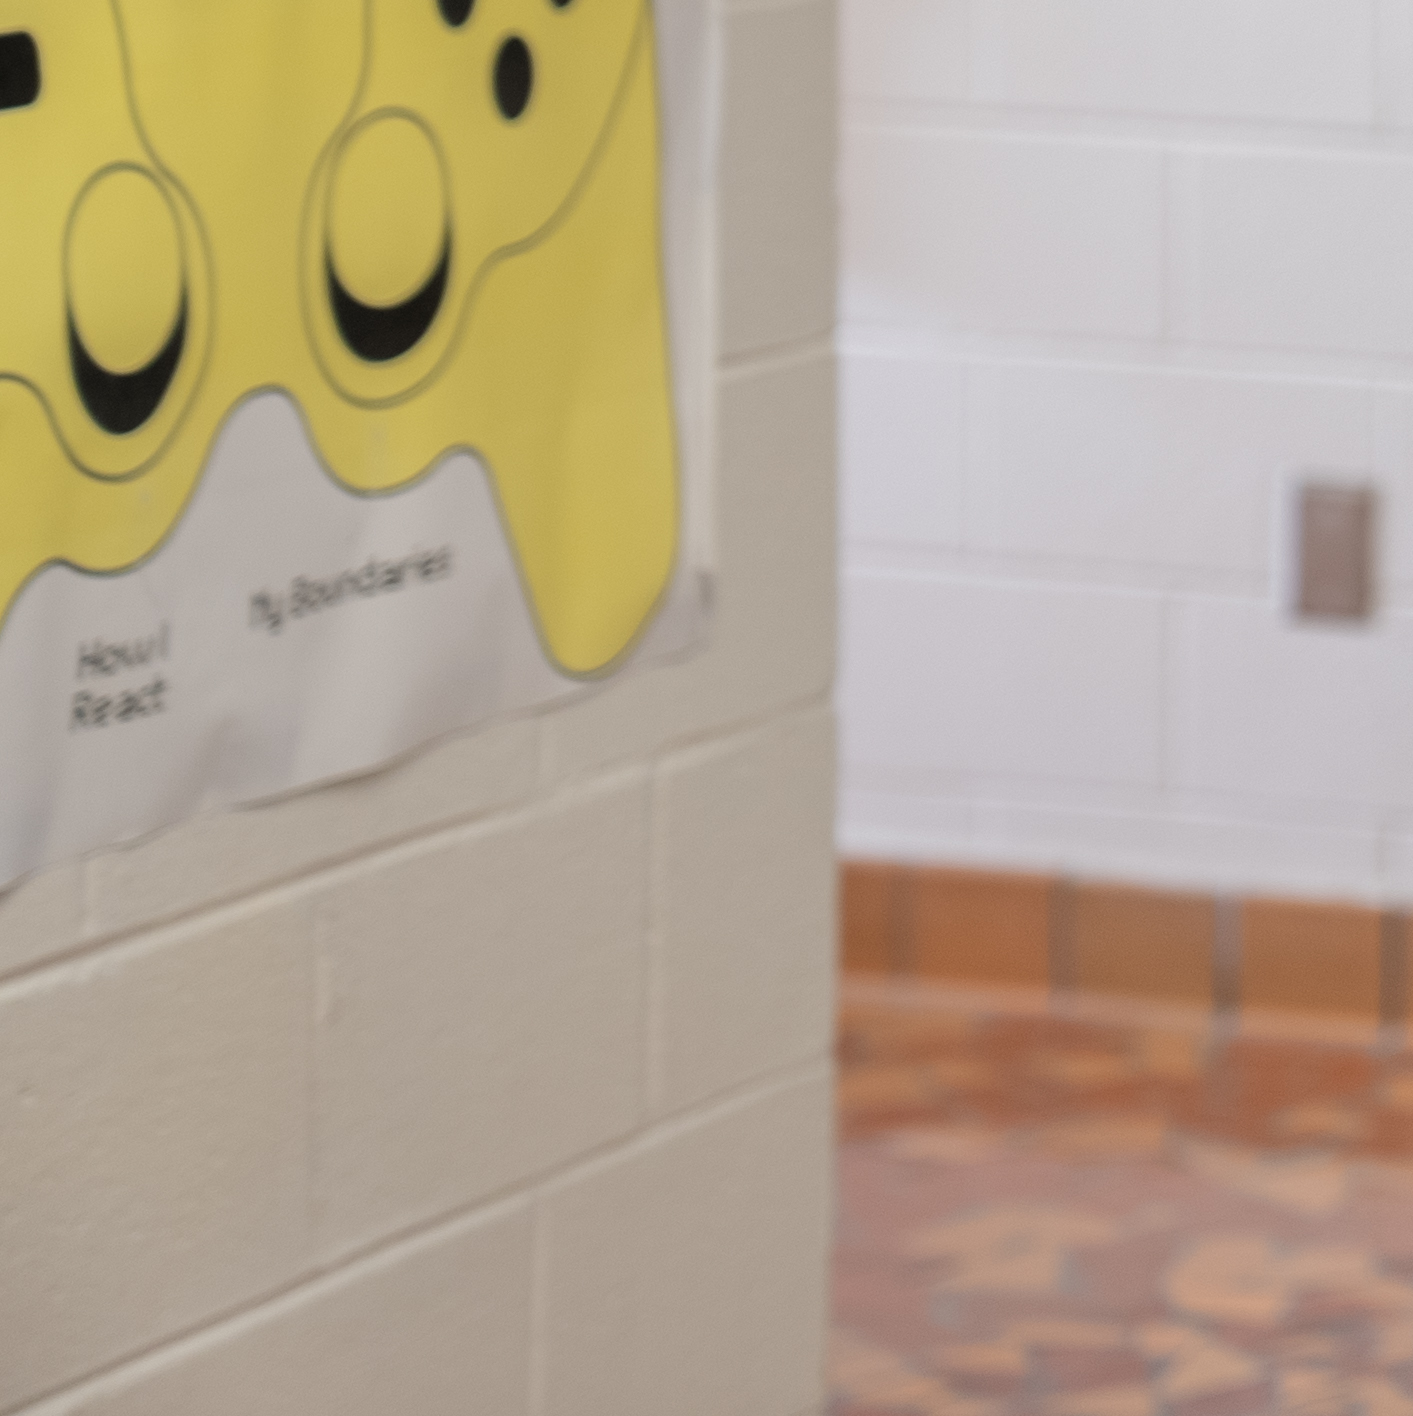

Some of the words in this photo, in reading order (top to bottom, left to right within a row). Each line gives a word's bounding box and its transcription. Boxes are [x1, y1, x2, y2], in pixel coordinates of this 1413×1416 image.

[249, 590, 286, 638] My
[291, 546, 453, 620] Boundaries
[76, 637, 157, 680] How
[70, 674, 167, 734] React
